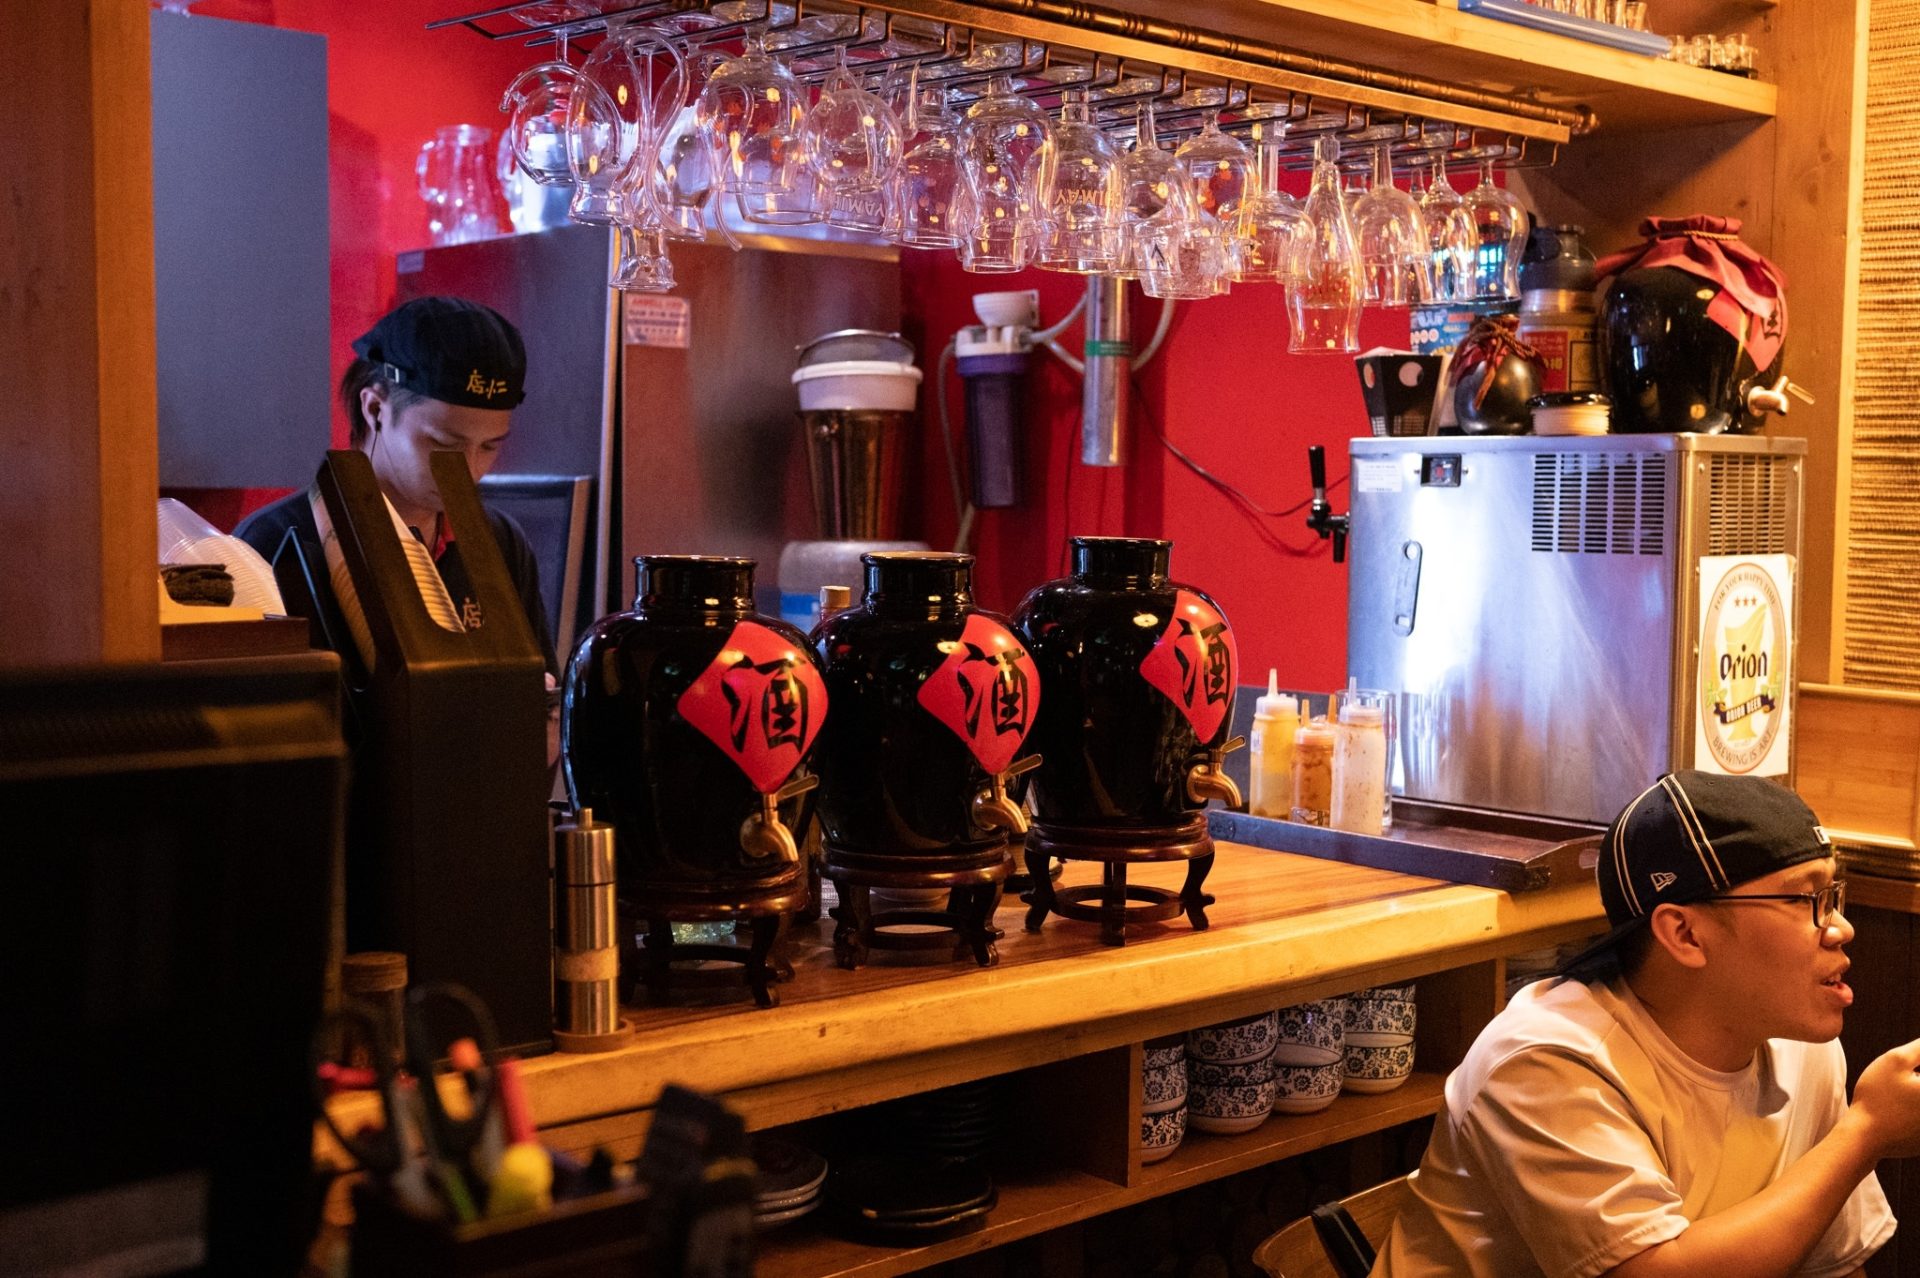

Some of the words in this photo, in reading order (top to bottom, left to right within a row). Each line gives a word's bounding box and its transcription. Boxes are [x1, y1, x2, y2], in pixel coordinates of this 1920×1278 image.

[466, 369, 508, 399] 店小二
[957, 642, 1025, 739] 酒
[1174, 617, 1230, 709] 酒
[721, 654, 807, 755] 酒
[1727, 704, 1745, 722] ORION
[1746, 696, 1762, 713] BEER
[1713, 735, 1748, 766] BREWING
[1750, 748, 1758, 762] IS
[1758, 728, 1773, 753] ART
